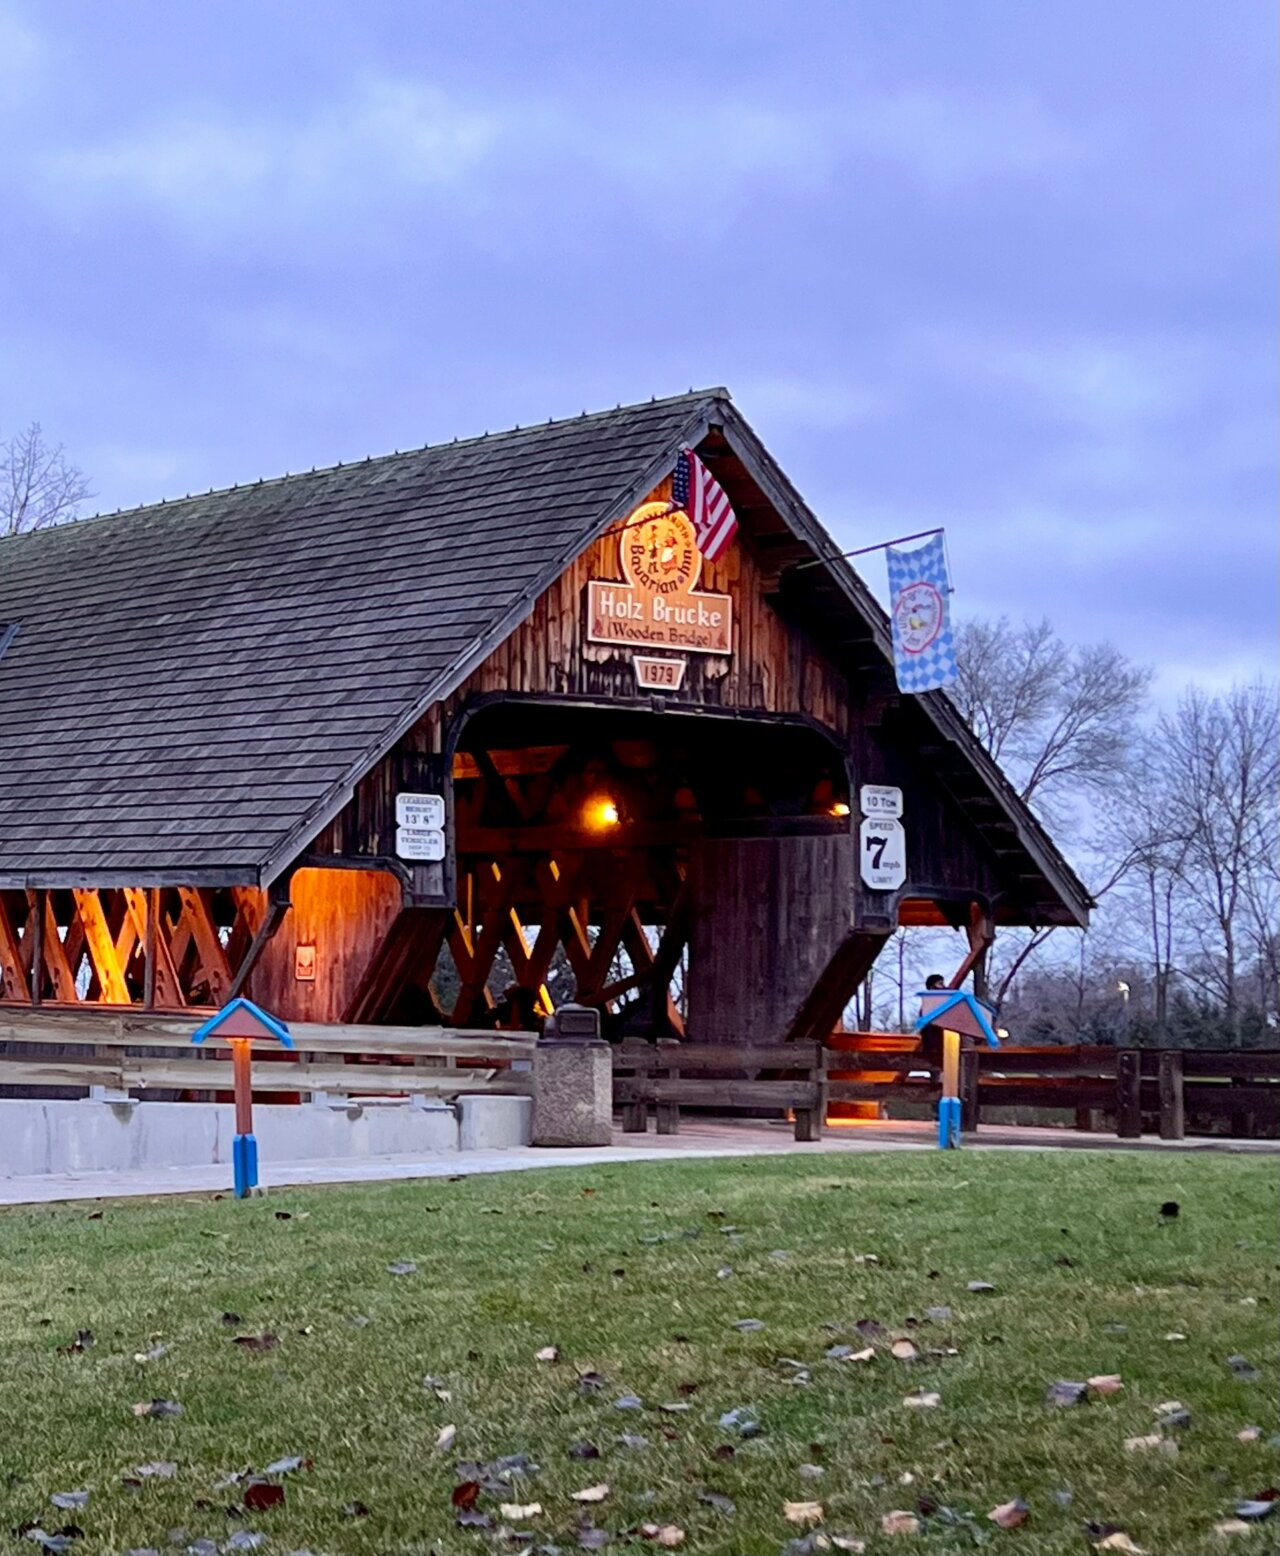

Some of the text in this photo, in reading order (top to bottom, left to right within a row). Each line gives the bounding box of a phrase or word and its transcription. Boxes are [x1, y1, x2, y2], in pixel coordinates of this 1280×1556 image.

[630, 545, 692, 593] Bavarian Inn
[600, 591, 644, 621] Holz
[607, 621, 713, 647] (Wooden Bridge)
[644, 665, 674, 683] 1979
[866, 796, 878, 807] 10
[869, 822, 894, 831] SPEED
[866, 836, 901, 871] 7 mph
[872, 876, 893, 884] LIMIT
